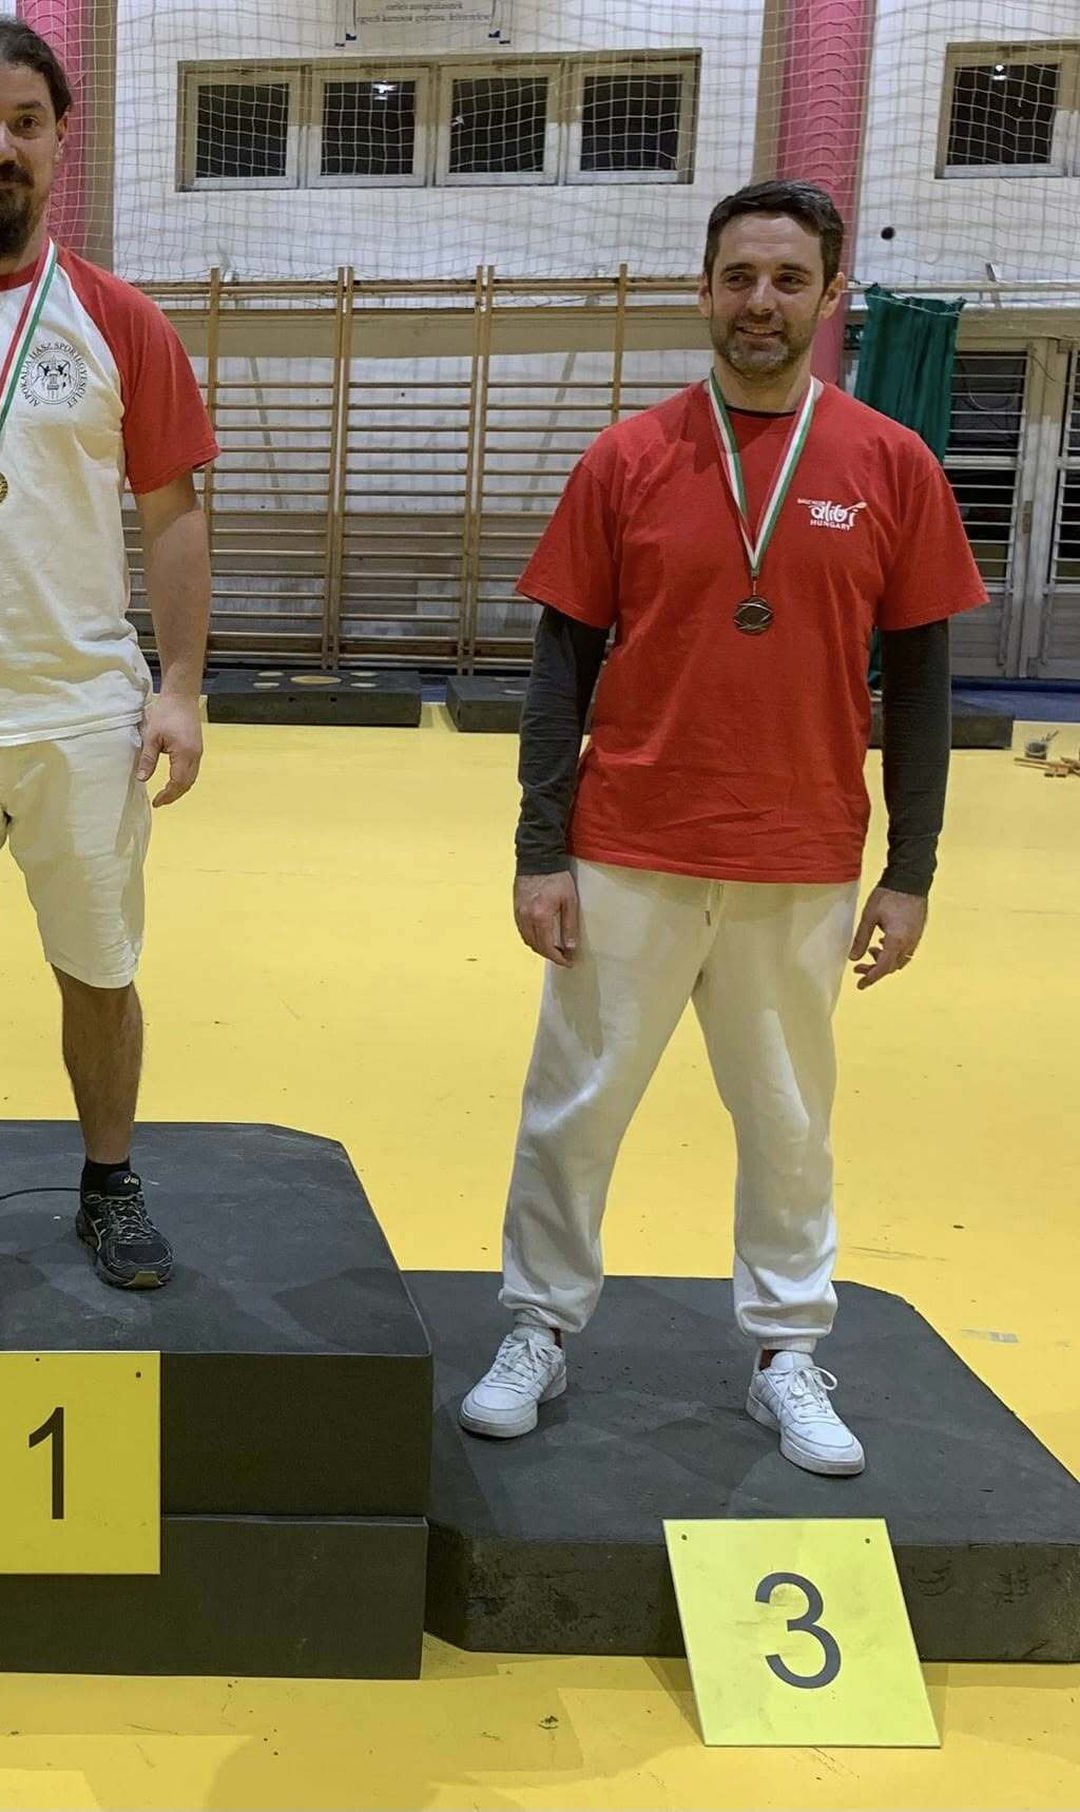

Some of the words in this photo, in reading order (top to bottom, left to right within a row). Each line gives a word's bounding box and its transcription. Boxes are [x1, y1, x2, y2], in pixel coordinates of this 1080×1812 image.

[810, 519, 850, 531] HUNGARY
[29, 1407, 64, 1520] 1
[755, 1572, 841, 1689] 3
